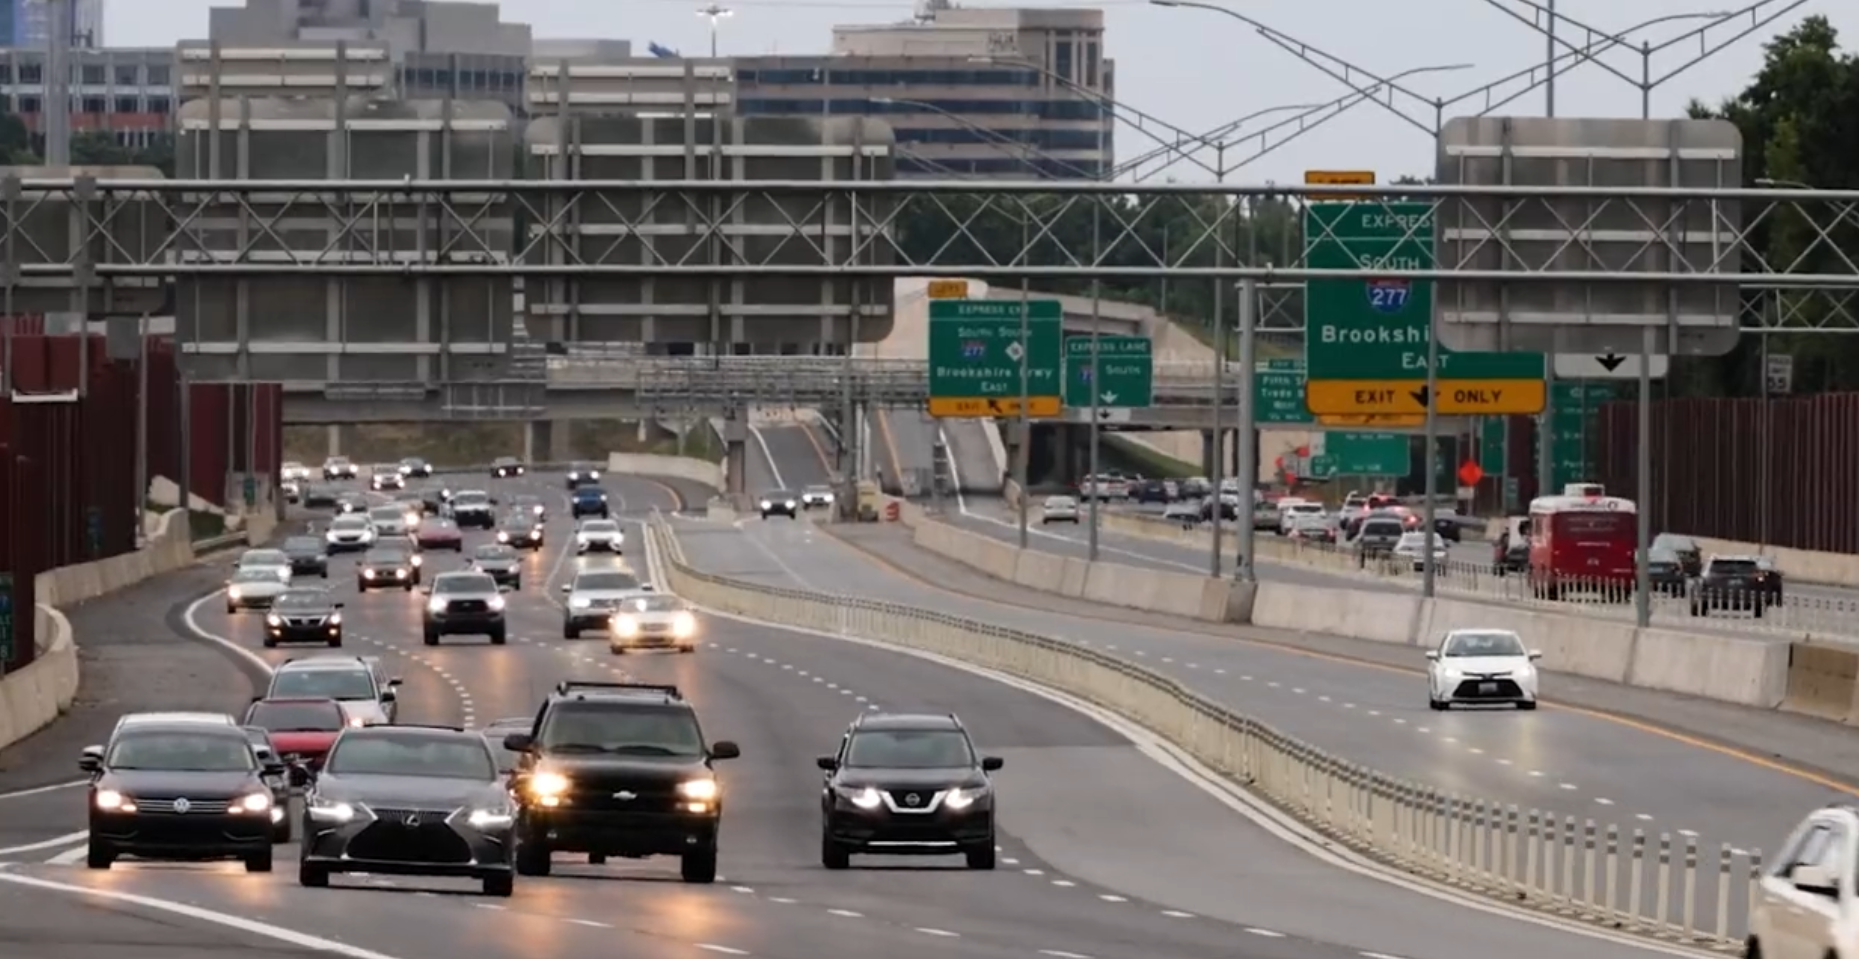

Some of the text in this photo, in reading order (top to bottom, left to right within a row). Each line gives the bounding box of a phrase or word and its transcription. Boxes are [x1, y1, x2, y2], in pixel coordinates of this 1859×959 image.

[1360, 254, 1419, 270] SOUTH
[1372, 288, 1407, 305] 277
[958, 305, 1004, 315] EXPRESS
[1402, 352, 1450, 368] EAT
[937, 367, 1012, 378] Brookshire
[1105, 364, 1140, 375] SOUTH
[981, 381, 1008, 392] EAST
[1355, 390, 1503, 403] EXIT ONLY
